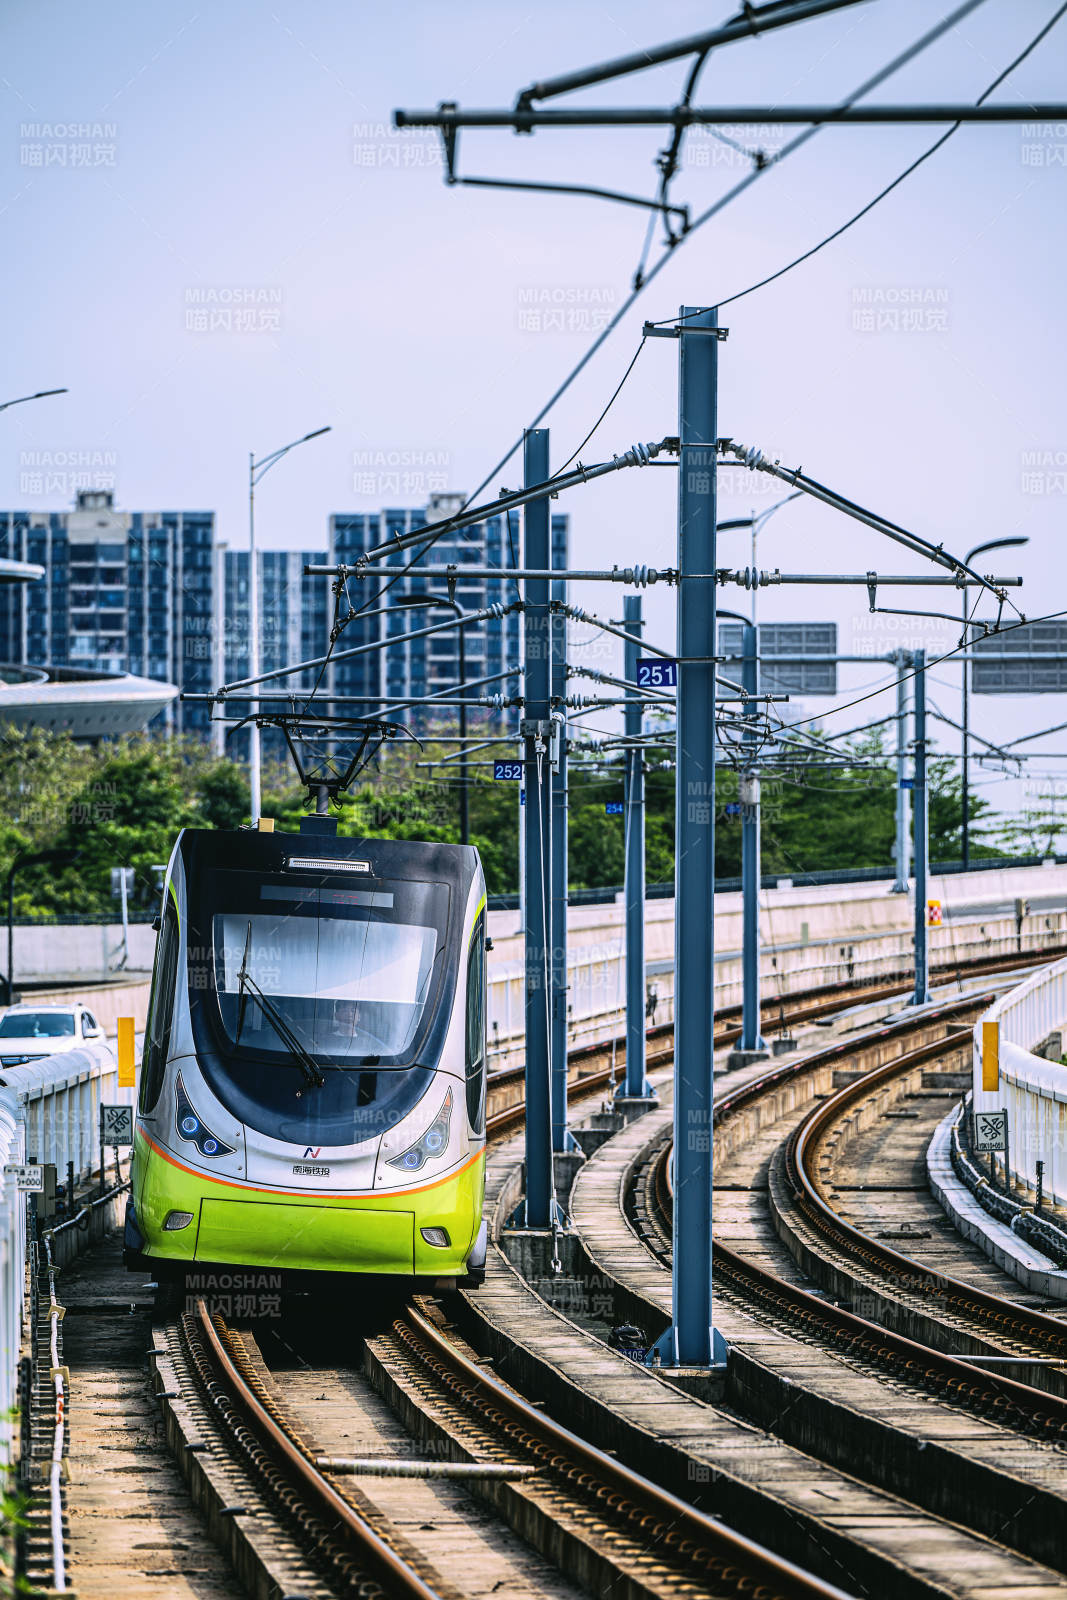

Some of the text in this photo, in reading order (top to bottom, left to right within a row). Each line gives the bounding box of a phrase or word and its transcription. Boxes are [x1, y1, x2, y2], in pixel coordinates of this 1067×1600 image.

[639, 665, 673, 685] 251
[495, 765, 521, 779] 252
[114, 1116, 130, 1134] 430
[991, 1117, 1004, 1129] 40
[980, 1124, 998, 1141] 429
[293, 1166, 330, 1176] 南海铁投
